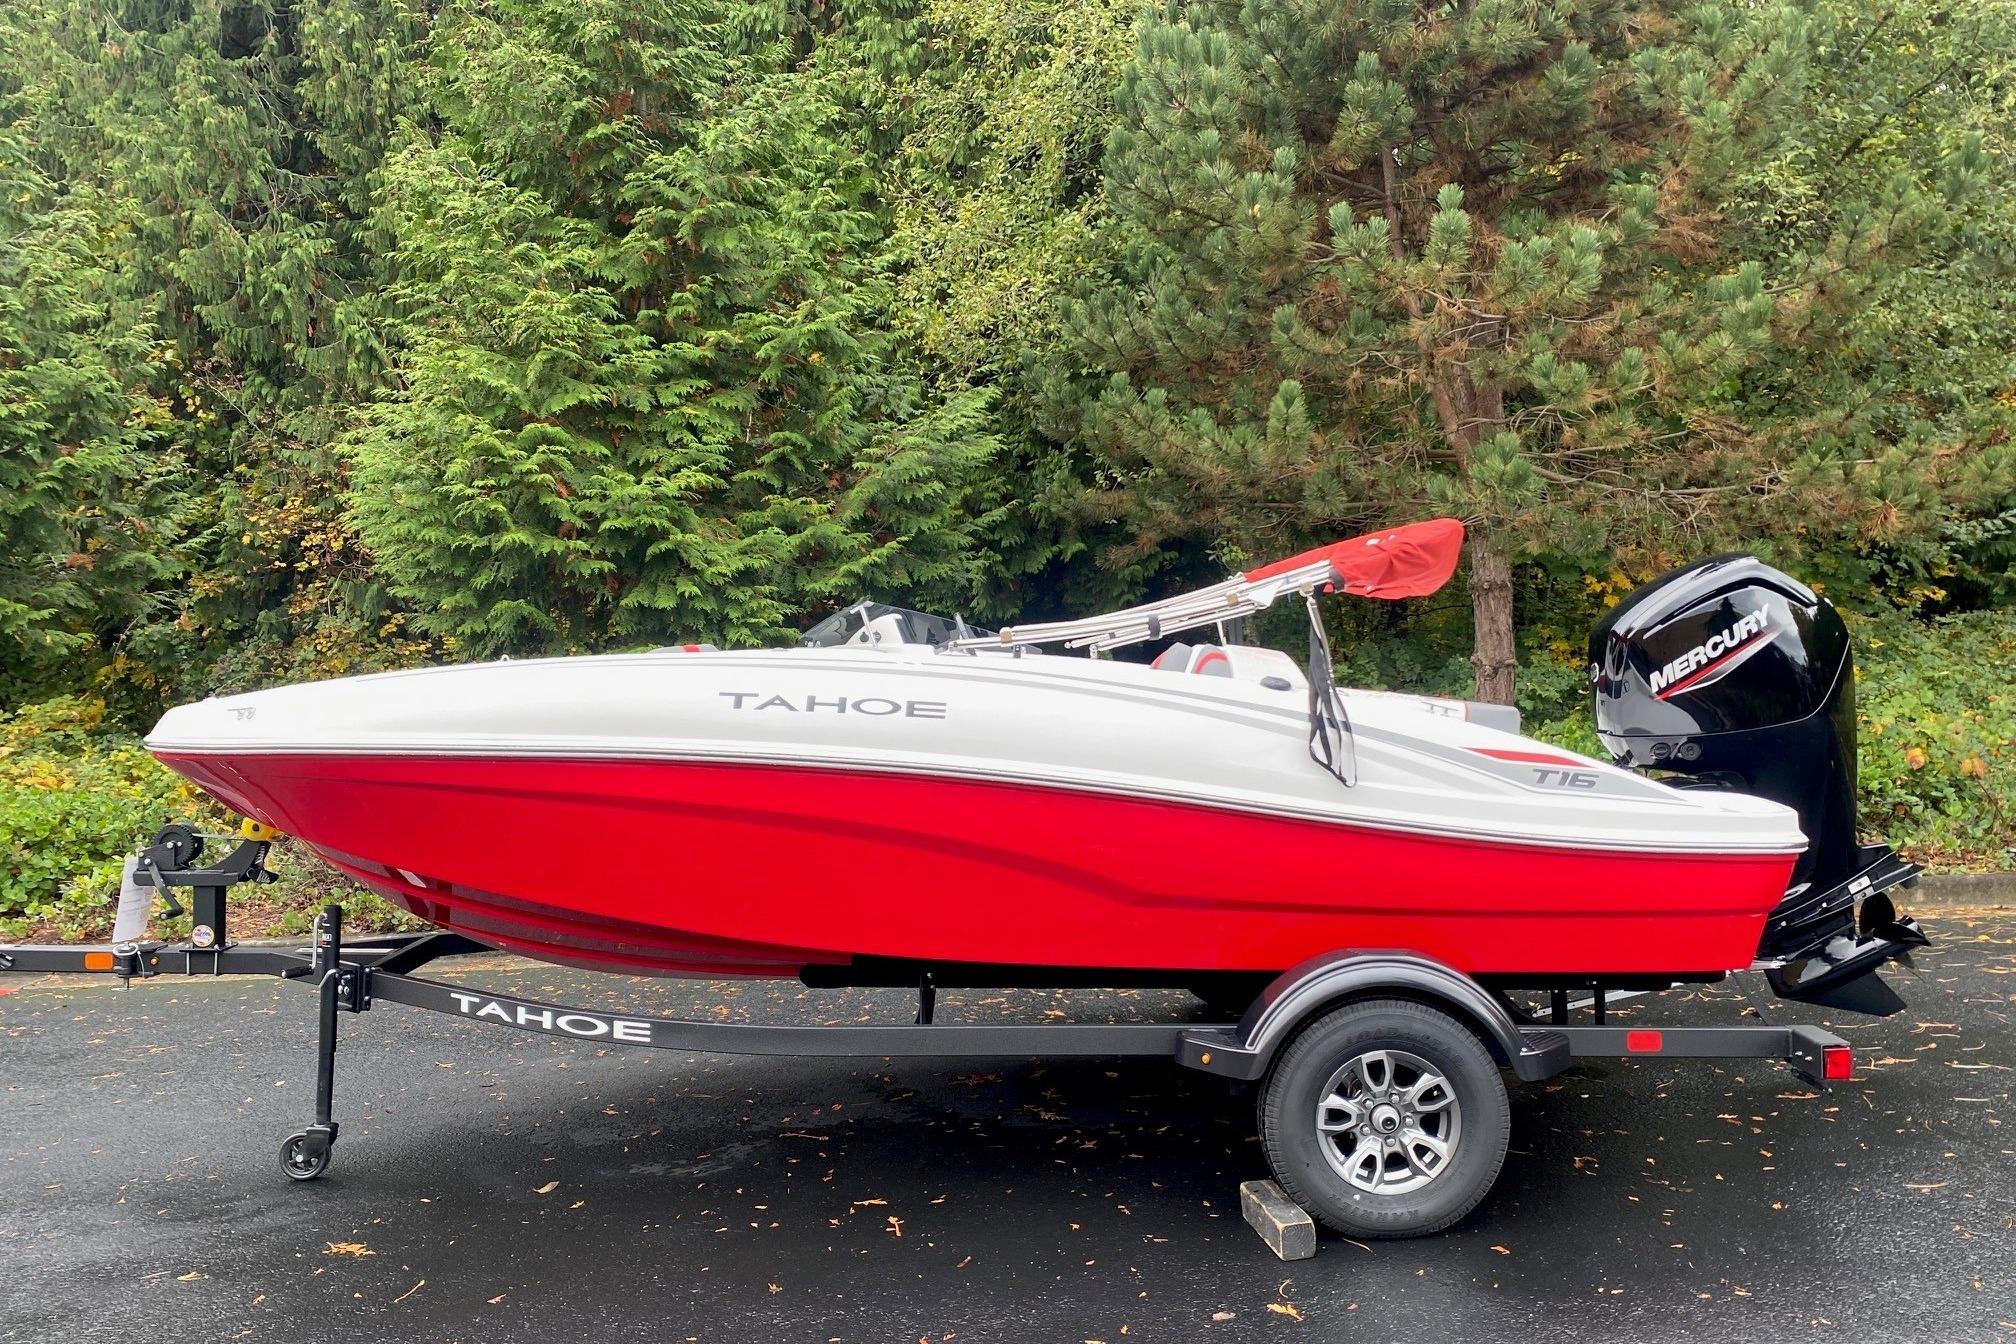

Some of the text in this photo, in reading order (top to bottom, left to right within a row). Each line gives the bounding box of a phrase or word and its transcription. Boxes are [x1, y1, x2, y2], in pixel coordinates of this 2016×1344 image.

[1649, 603, 1769, 694] MERCURY
[719, 692, 947, 719] TAHOE
[1533, 768, 1600, 789] T16
[450, 992, 651, 1043] TAHOE
